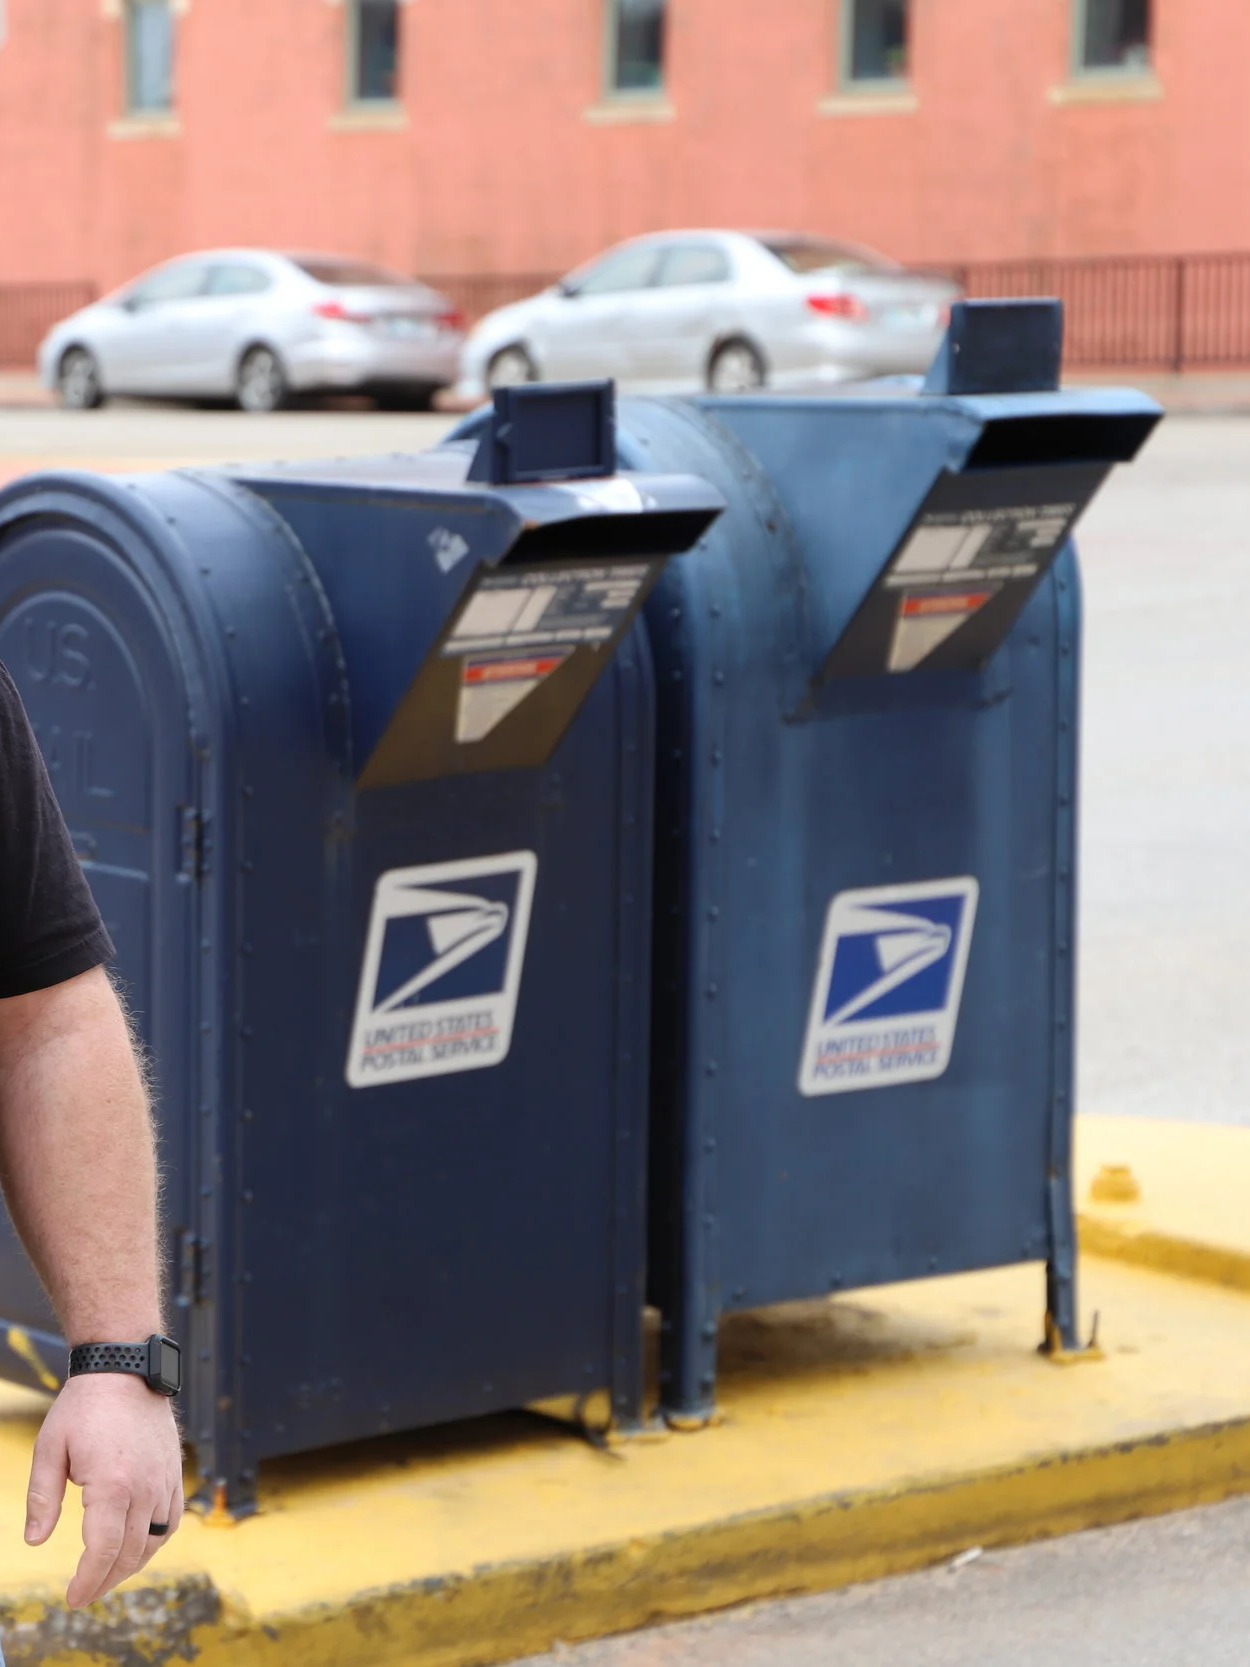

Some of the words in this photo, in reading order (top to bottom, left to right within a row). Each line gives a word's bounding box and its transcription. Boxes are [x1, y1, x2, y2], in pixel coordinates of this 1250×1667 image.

[365, 1021, 434, 1046] UNITED
[436, 1012, 493, 1034] STATES
[361, 1048, 424, 1071] POSTAL
[433, 1037, 494, 1060] SERVICE
[817, 1035, 879, 1057] UNITED
[814, 1060, 871, 1081] POSTAL
[879, 1050, 937, 1071] SERVICE
